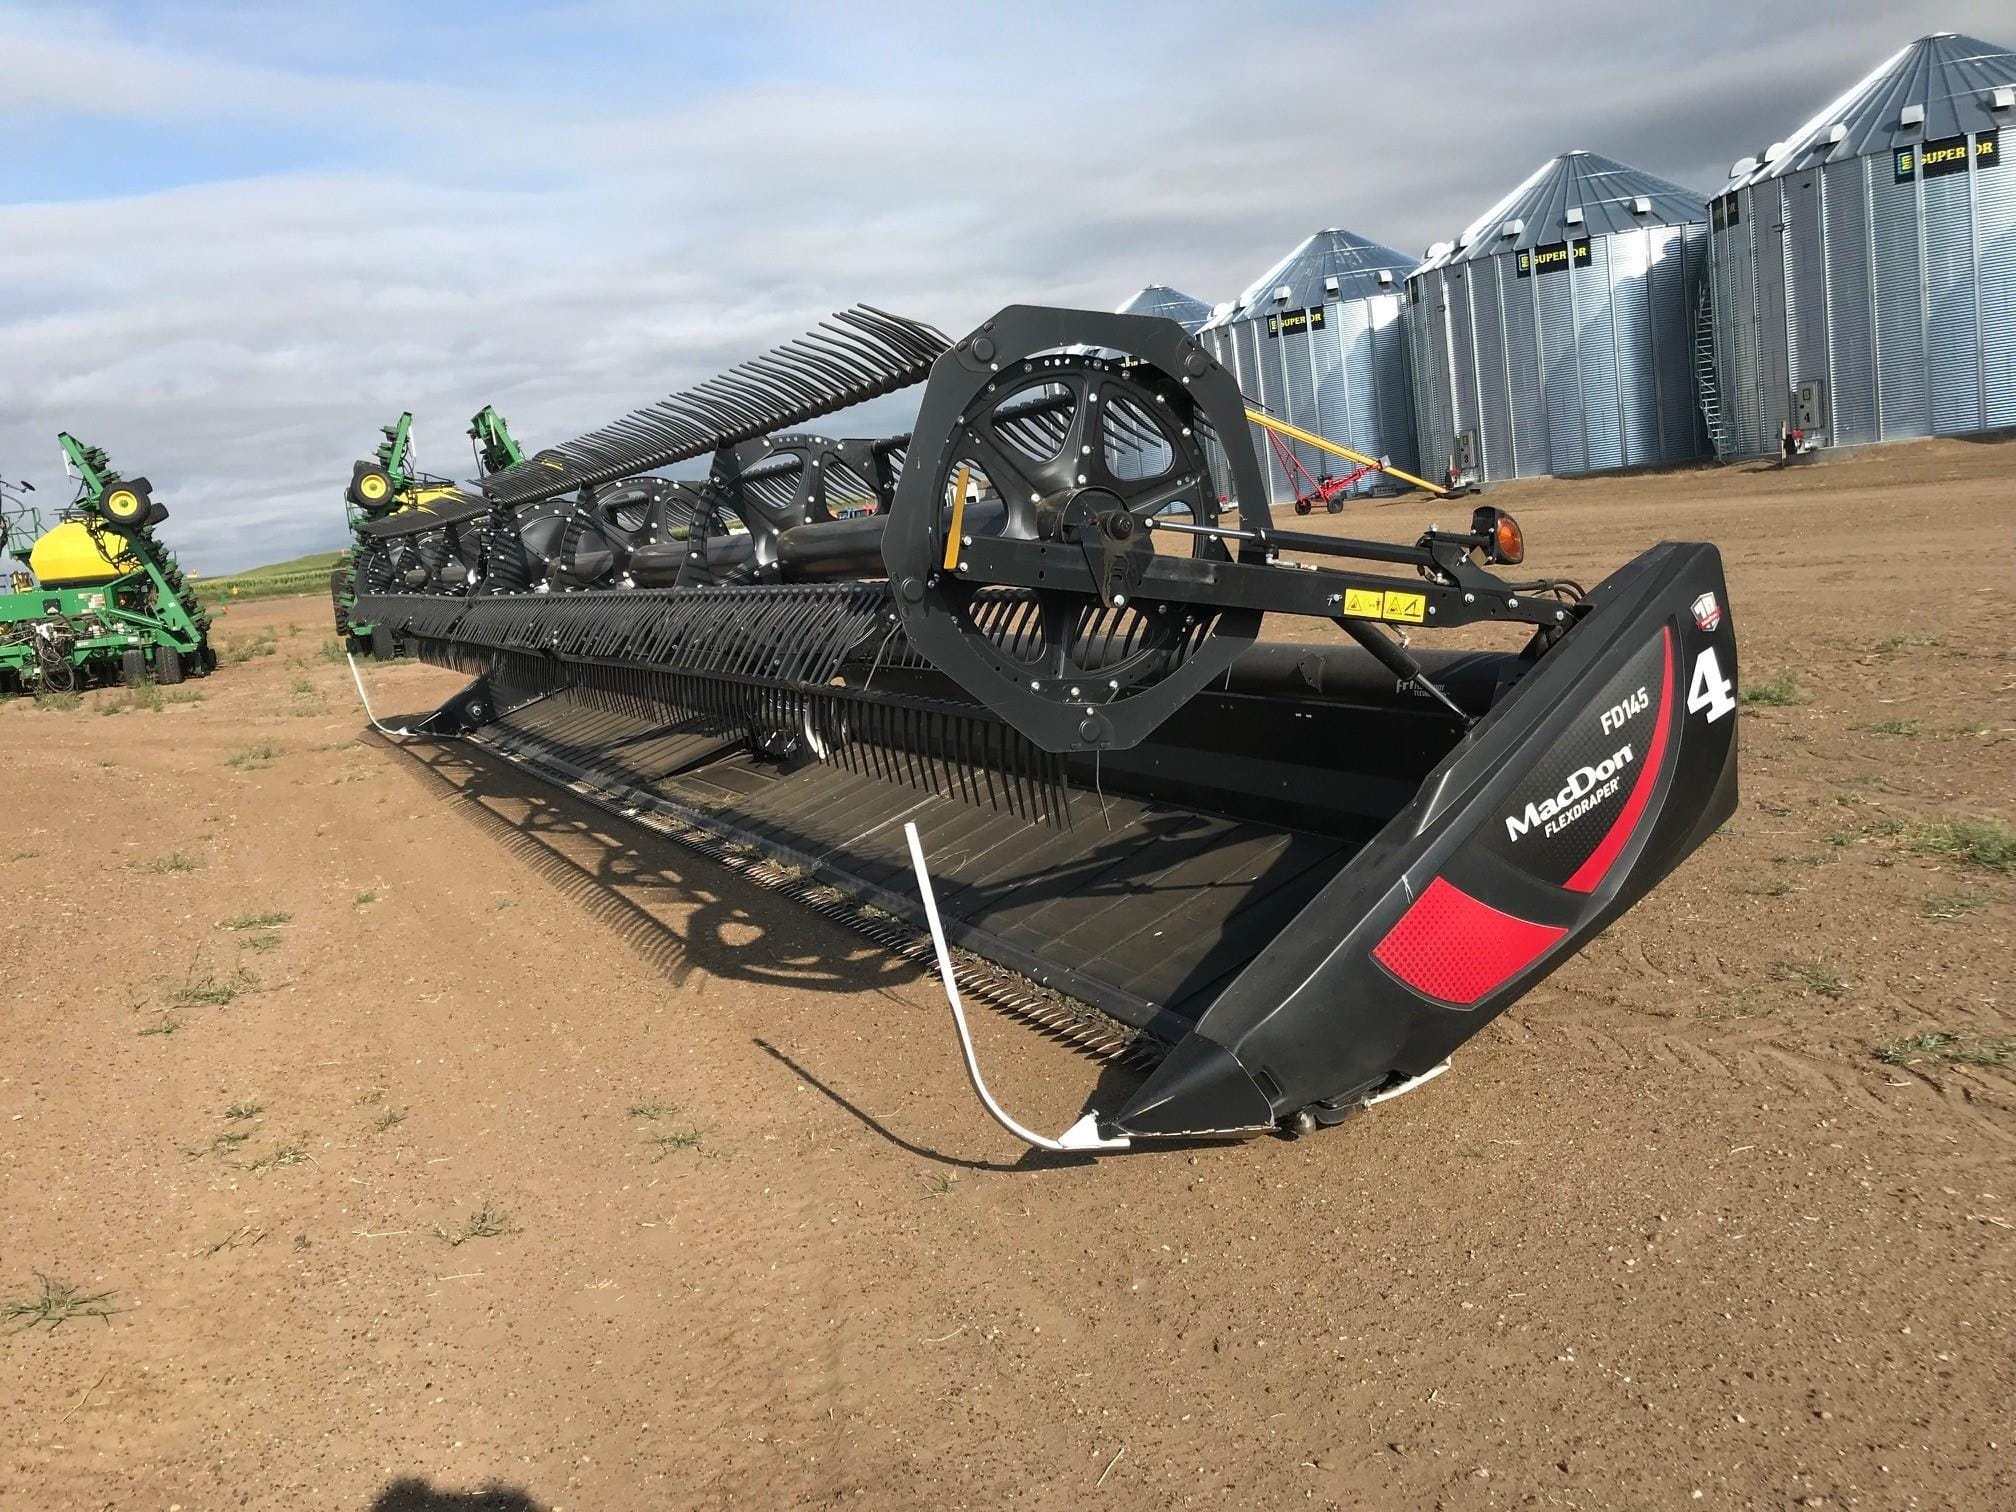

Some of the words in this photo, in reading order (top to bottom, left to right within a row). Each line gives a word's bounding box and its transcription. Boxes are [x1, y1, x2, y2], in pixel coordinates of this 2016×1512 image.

[1920, 142, 1993, 166] SUPEROR
[1534, 247, 1586, 265] SUPEROR
[1280, 313, 1322, 328] SUPEROR
[1687, 646, 1736, 724] 4
[1600, 686, 1649, 736] FD145
[1505, 745, 1634, 842] MacDon
[1545, 777, 1618, 838] FLEXDRAPER
